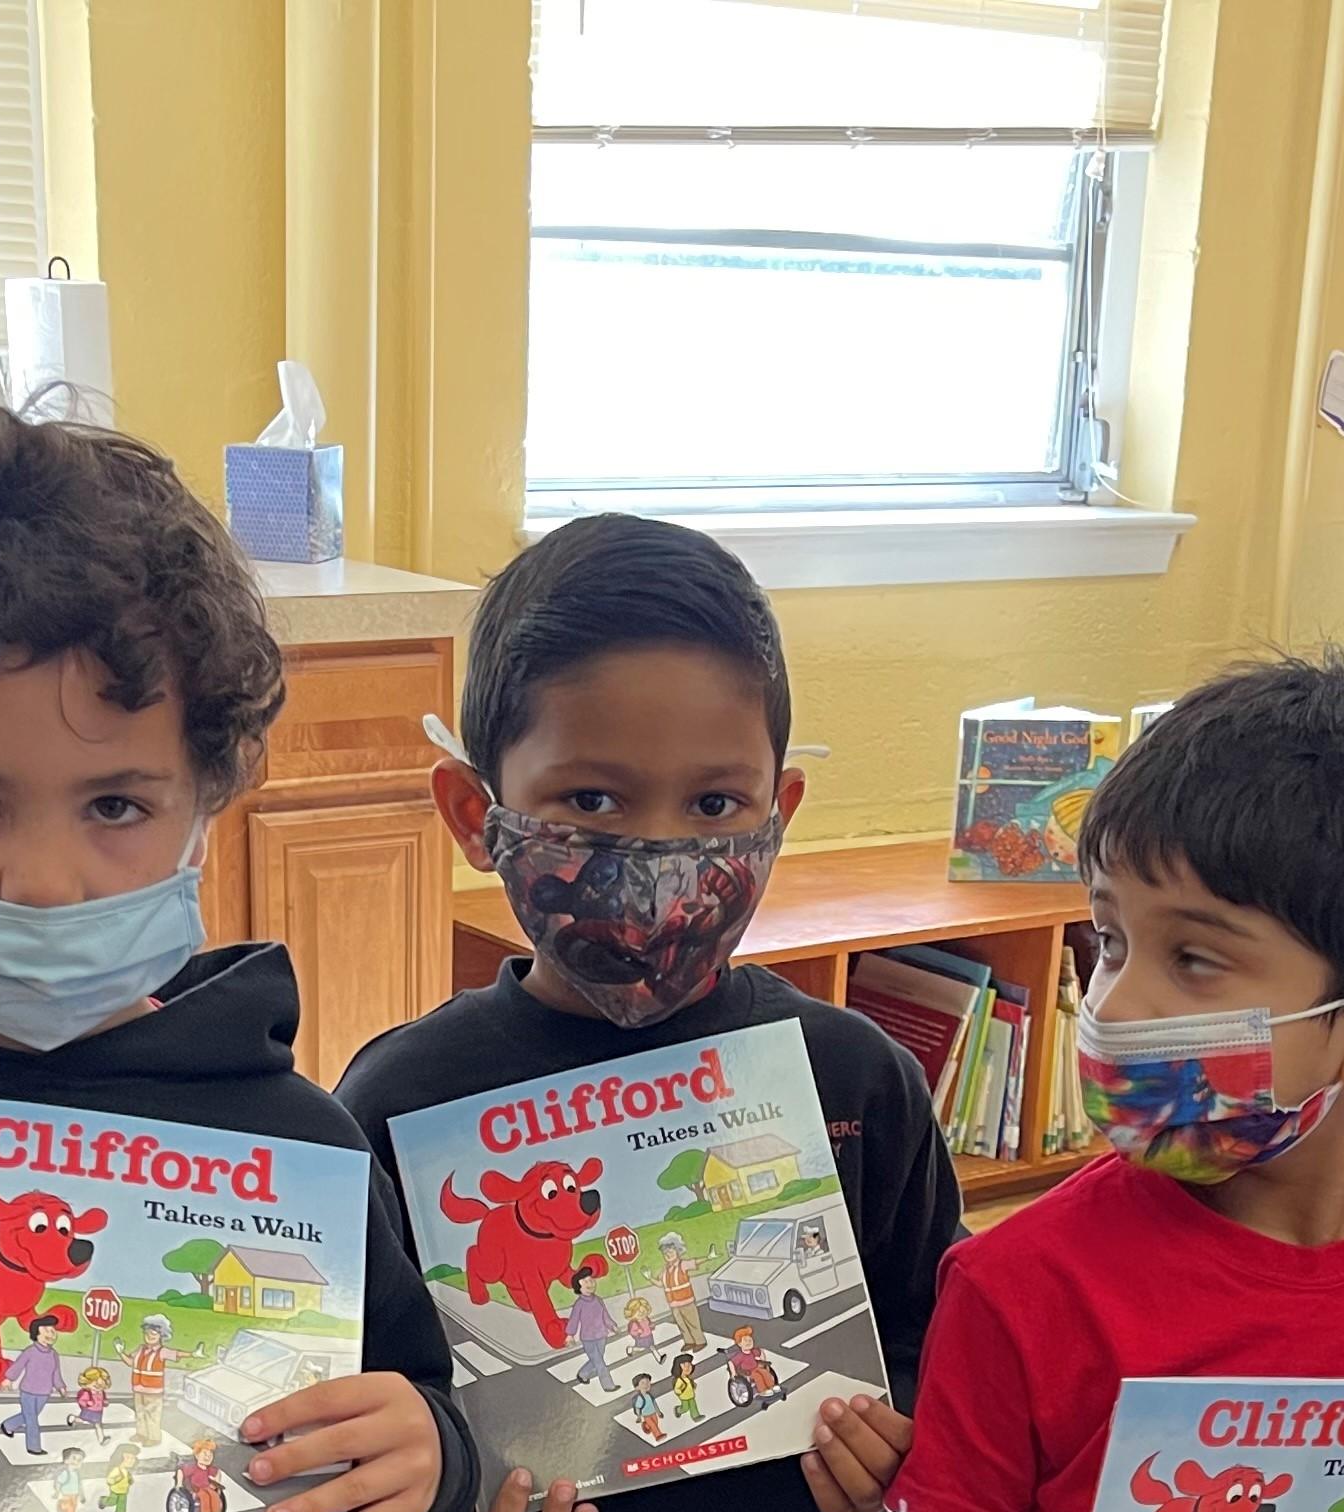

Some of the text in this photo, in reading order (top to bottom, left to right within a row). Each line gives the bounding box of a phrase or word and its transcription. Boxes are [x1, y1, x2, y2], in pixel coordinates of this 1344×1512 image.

[983, 728, 1089, 748] Good Night God
[479, 1048, 734, 1153] Clifford
[627, 1102, 783, 1151] Takes a Walk
[829, 1121, 862, 1137] ERC
[144, 1200, 322, 1243] Takes a Walk
[607, 1235, 636, 1255] STOP
[86, 1298, 118, 1321] STOP
[638, 1438, 745, 1471] SCHOLASTIC
[576, 1474, 605, 1489] dwell
